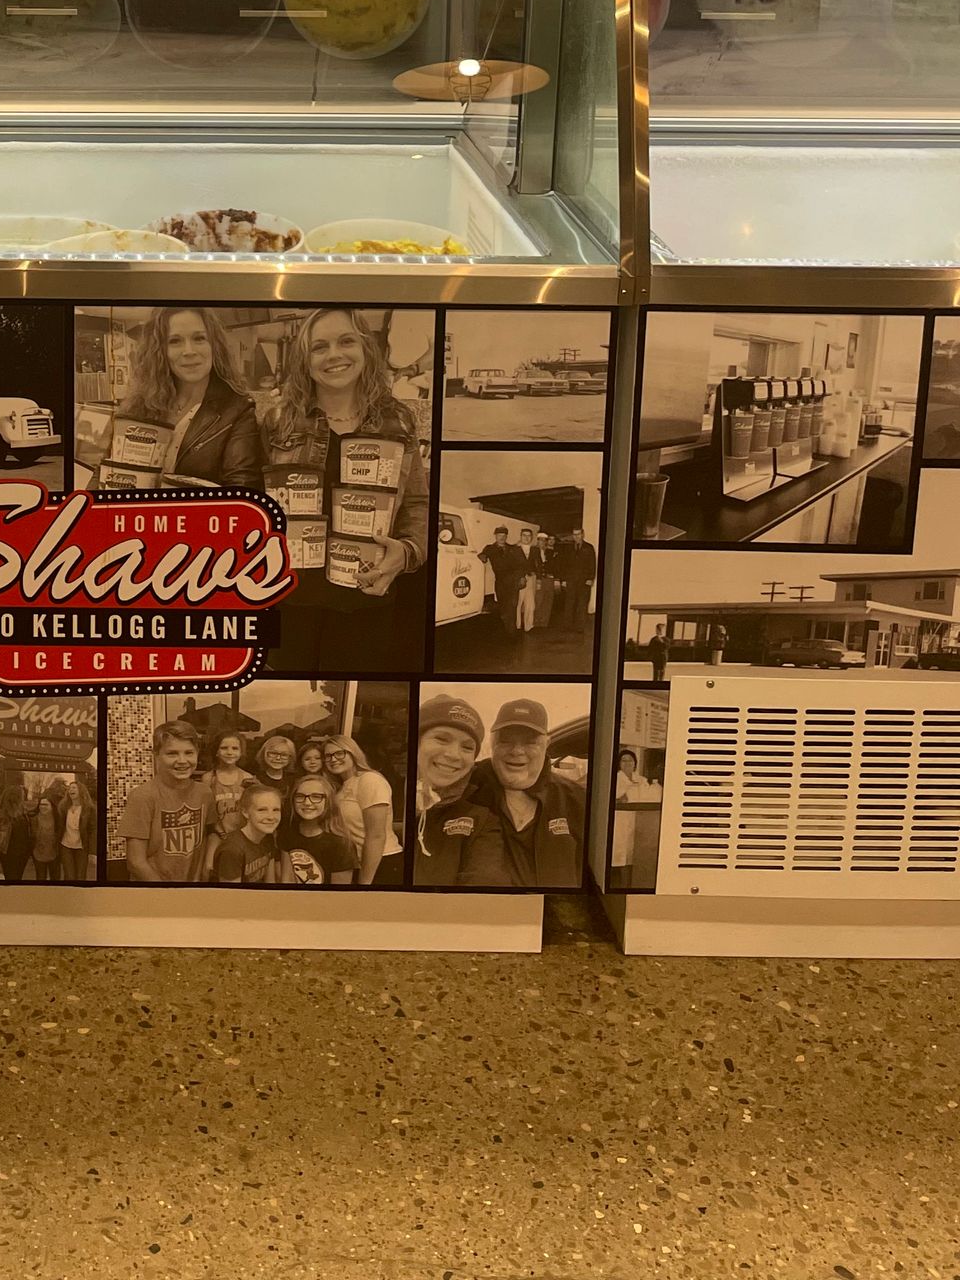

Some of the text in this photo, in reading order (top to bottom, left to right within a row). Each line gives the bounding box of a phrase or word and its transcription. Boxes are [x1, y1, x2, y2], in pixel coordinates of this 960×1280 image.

[351, 468, 370, 476] CHIP
[114, 515, 238, 534] HOME OF
[33, 613, 166, 640] KELLOGG
[184, 616, 258, 640] LANE
[64, 728, 94, 738] BAR
